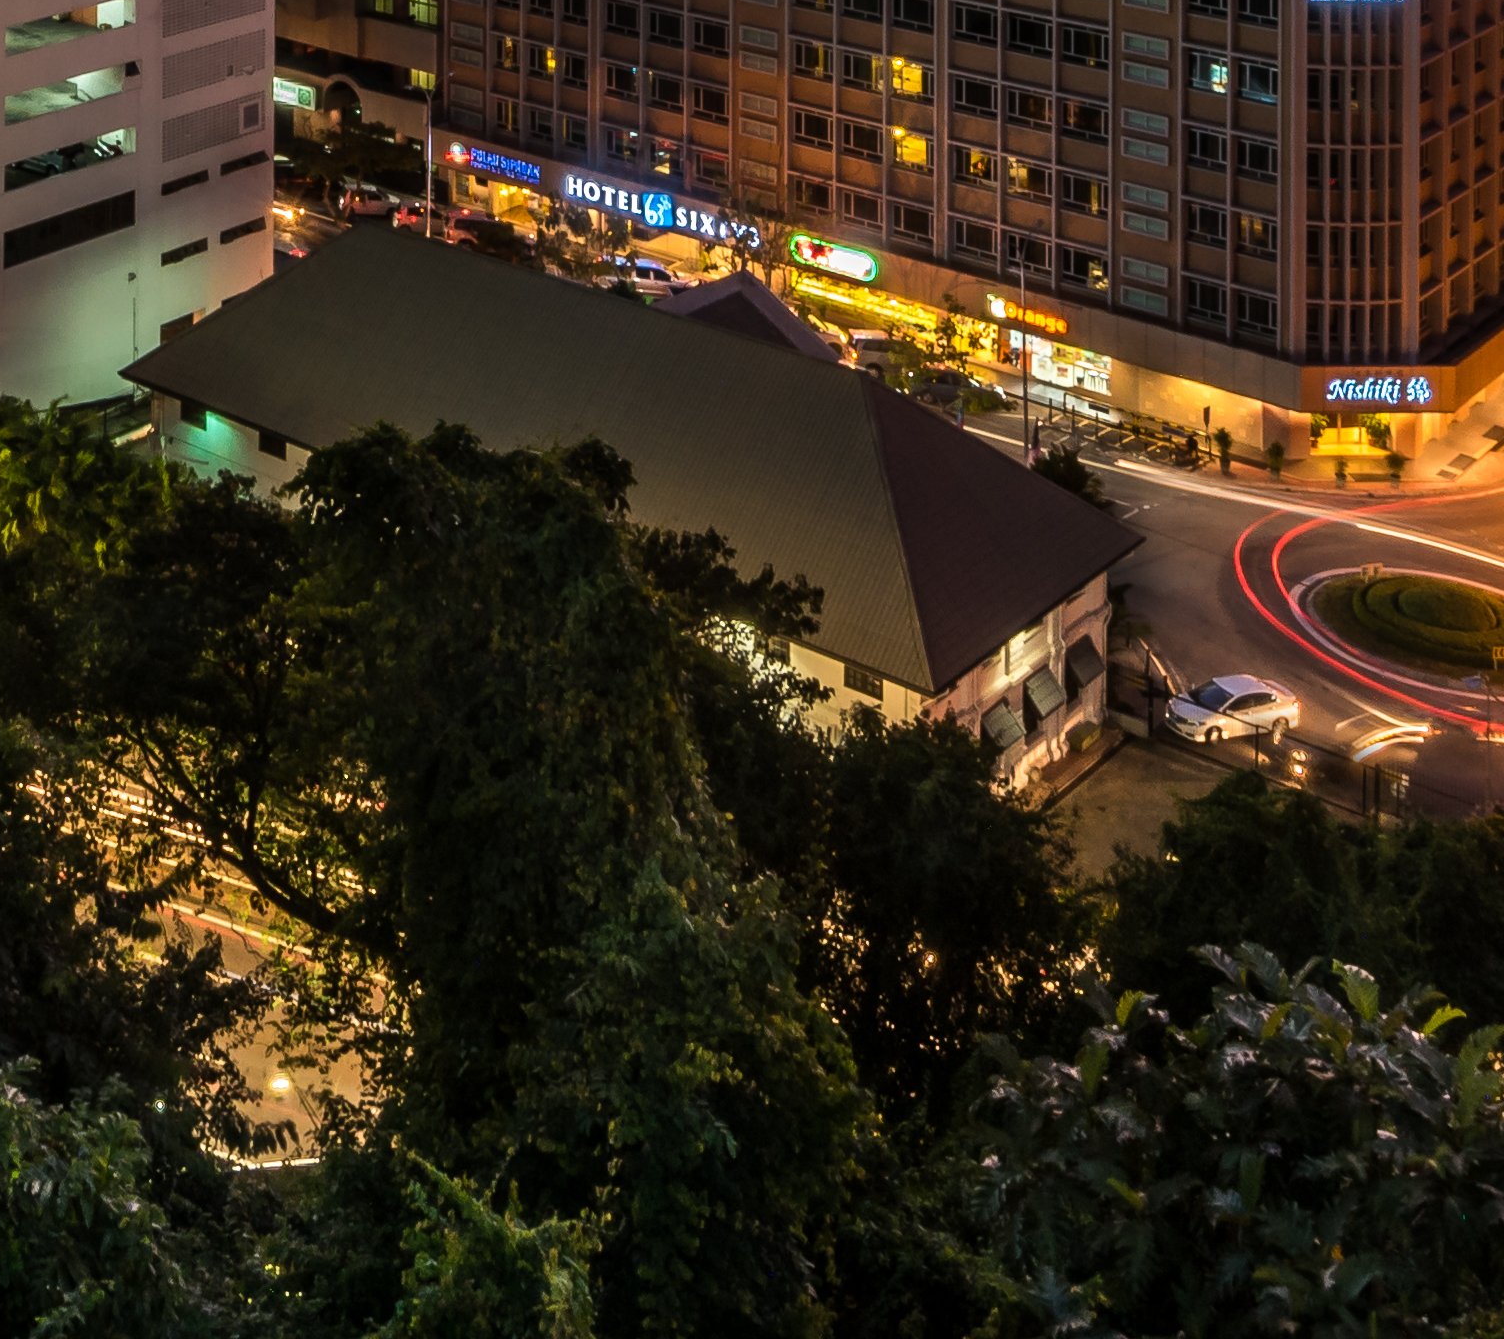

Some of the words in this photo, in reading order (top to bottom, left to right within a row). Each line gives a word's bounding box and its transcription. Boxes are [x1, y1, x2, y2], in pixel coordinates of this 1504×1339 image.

[567, 175, 643, 216] HOTEL
[1004, 301, 1068, 335] Orange
[1326, 376, 1402, 405] Nishiki
